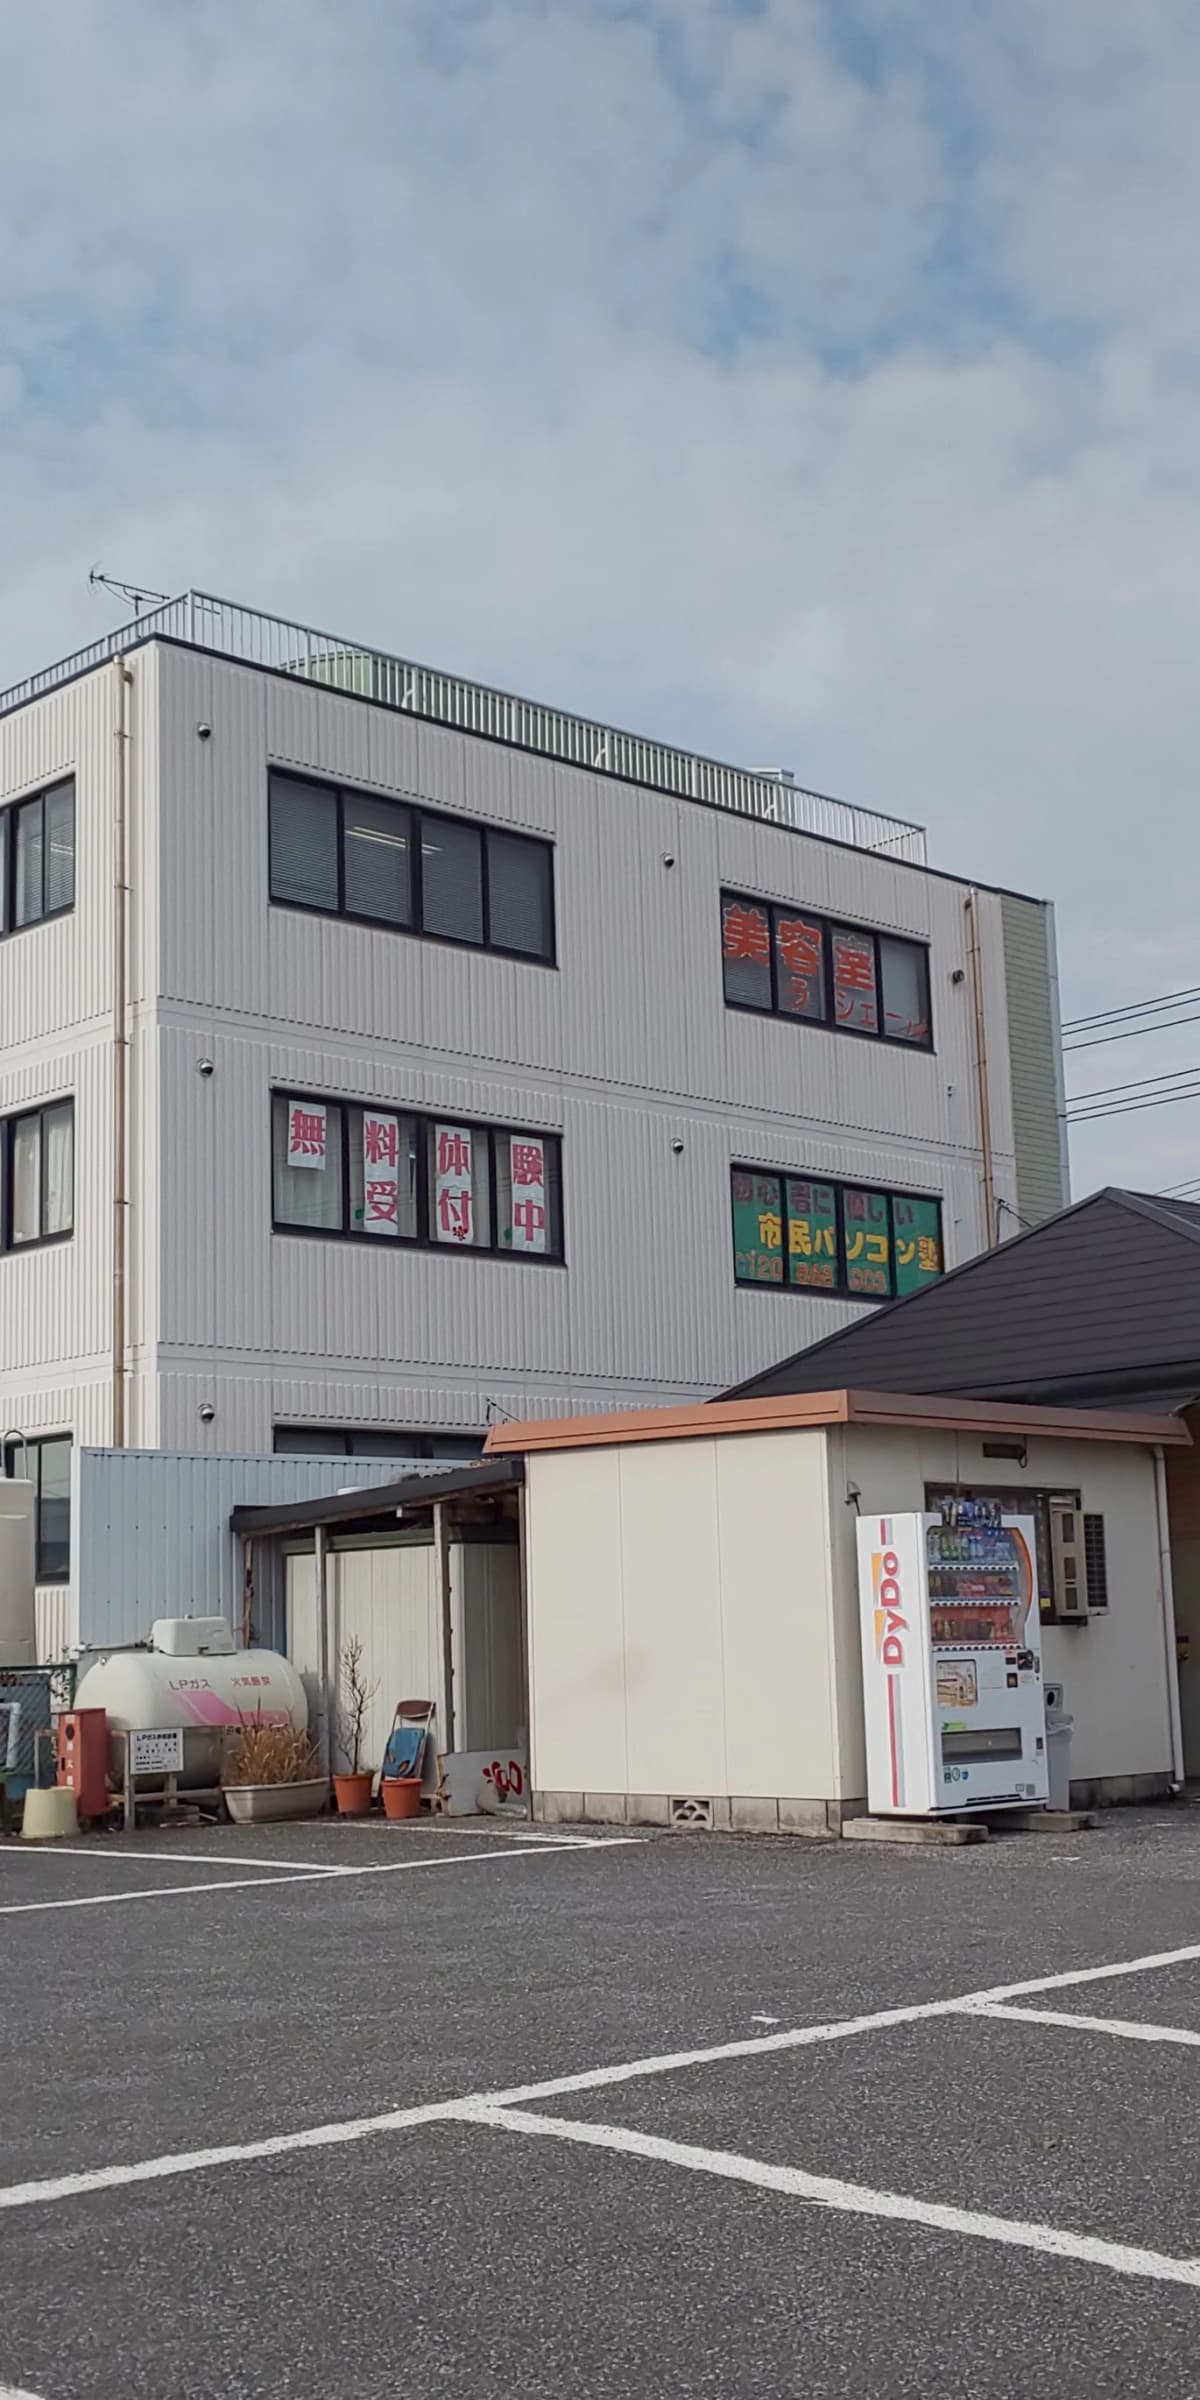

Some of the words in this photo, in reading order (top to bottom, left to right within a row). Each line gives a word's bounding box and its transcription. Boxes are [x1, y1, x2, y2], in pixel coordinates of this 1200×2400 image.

[723, 904, 875, 992] 美容室
[290, 1108, 546, 1187] 無料体験
[366, 1181, 547, 1242] 受付中
[758, 1212, 939, 1272] 市民パソコン塾
[880, 1551, 909, 1665] DyDo
[168, 1678, 212, 1691] LPガス
